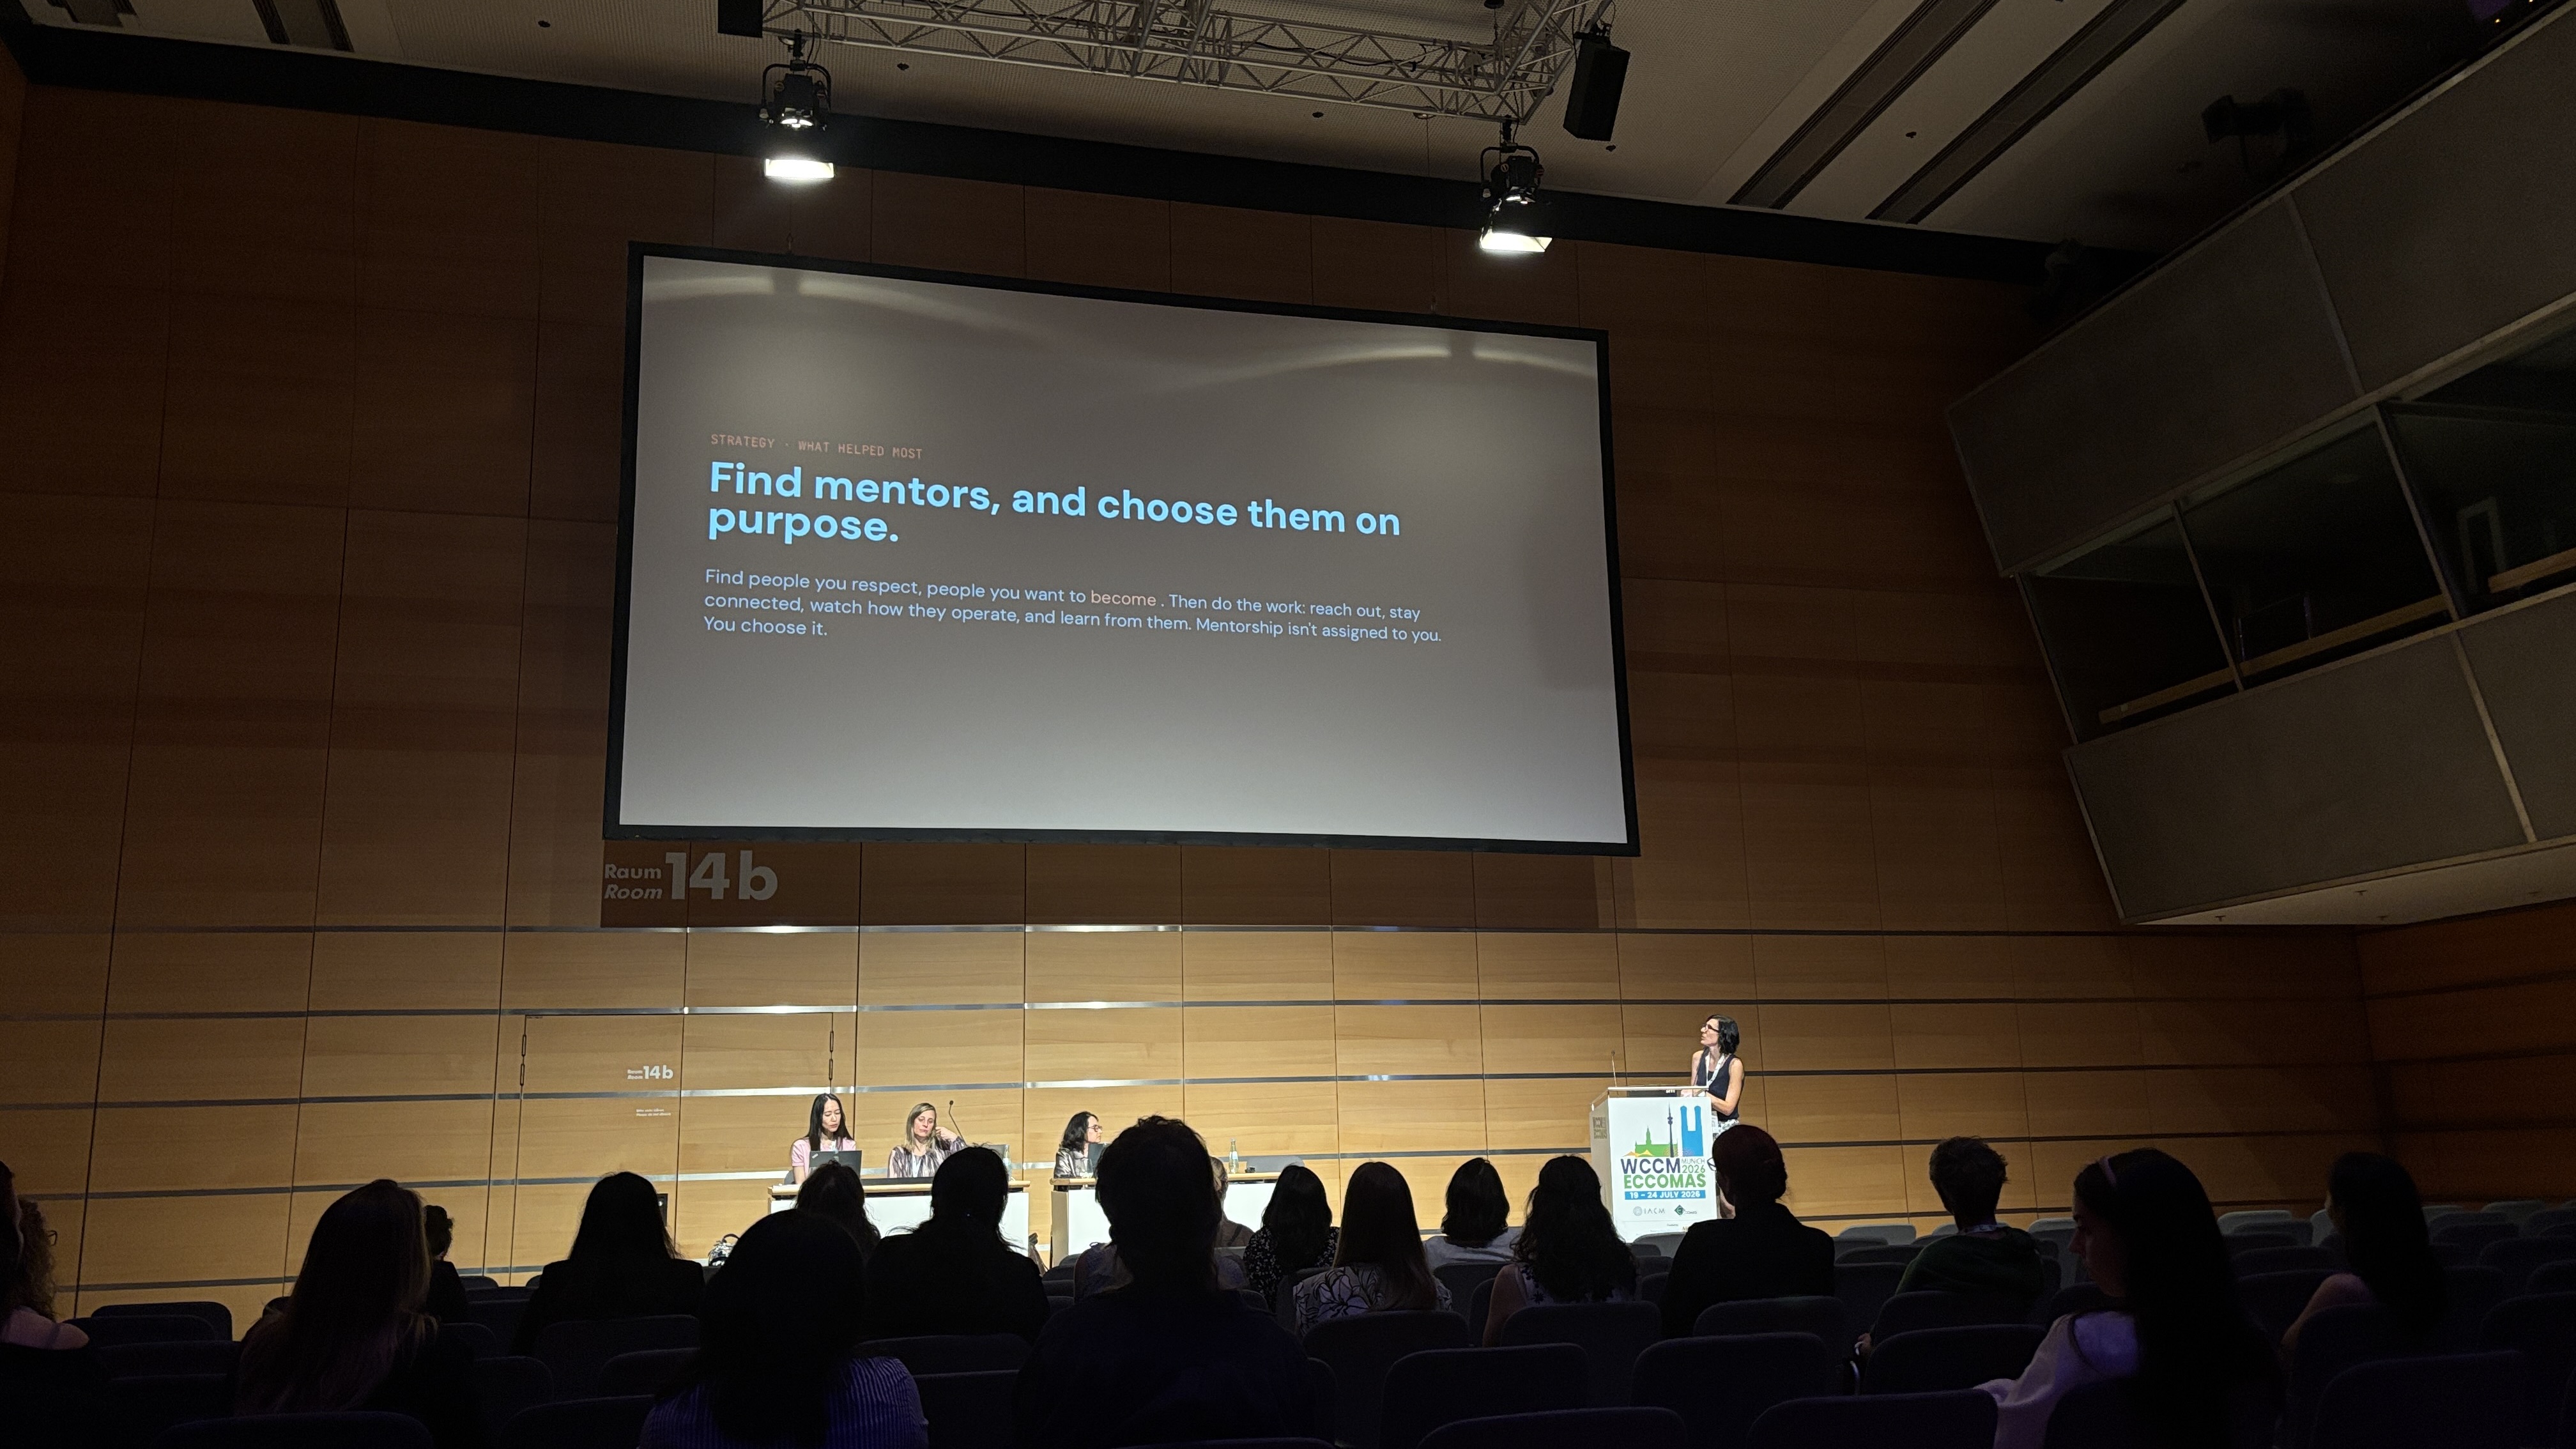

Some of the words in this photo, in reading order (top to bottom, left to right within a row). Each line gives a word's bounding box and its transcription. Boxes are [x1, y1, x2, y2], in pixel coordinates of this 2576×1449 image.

[711, 434, 775, 448] STRATEGY
[798, 441, 830, 452] WHAT
[838, 443, 884, 456] HELPED
[893, 447, 923, 459] MOST
[710, 461, 802, 498] Find
[815, 476, 1000, 516] mentors,
[1012, 486, 1085, 517] and
[1097, 489, 1238, 526] choose
[1247, 498, 1346, 533] them
[1356, 512, 1400, 536] on
[708, 508, 899, 545] purpose.
[705, 569, 744, 585] Find
[748, 573, 810, 591] people
[815, 578, 847, 593] you
[852, 580, 922, 597] respect,
[927, 583, 986, 601] people
[989, 587, 1020, 602] you
[1024, 589, 1065, 602] want
[1069, 590, 1086, 603] to
[1091, 589, 1156, 606] become
[1169, 594, 1208, 610] Then
[1211, 596, 1232, 611] do
[1236, 597, 1262, 612] the
[1266, 600, 1306, 614] work:
[1310, 602, 1352, 617] reach
[1356, 606, 1386, 620] out,
[1389, 607, 1421, 623] stay
[703, 616, 735, 632] You
[740, 618, 807, 635] choose
[812, 620, 827, 636] it.
[704, 595, 804, 613] connected,
[809, 599, 862, 615] watch
[868, 600, 903, 617] how
[908, 602, 947, 622] they
[951, 608, 1020, 624] operate,
[1025, 610, 1055, 624] and
[1061, 610, 1100, 626] learn
[1104, 613, 1142, 628] from
[1146, 615, 1192, 631] them.
[1196, 617, 1284, 638] Mentorship
[1288, 622, 1317, 636] isn't
[1322, 624, 1388, 642] assigned
[1392, 628, 1407, 640] to
[1411, 631, 1442, 644] you.
[604, 863, 662, 879] Raum
[604, 884, 663, 900] Room
[1620, 1158, 1681, 1174] WCCM
[1682, 1164, 1706, 1174] 2026
[1623, 1173, 1706, 1189] ECCOMAS
